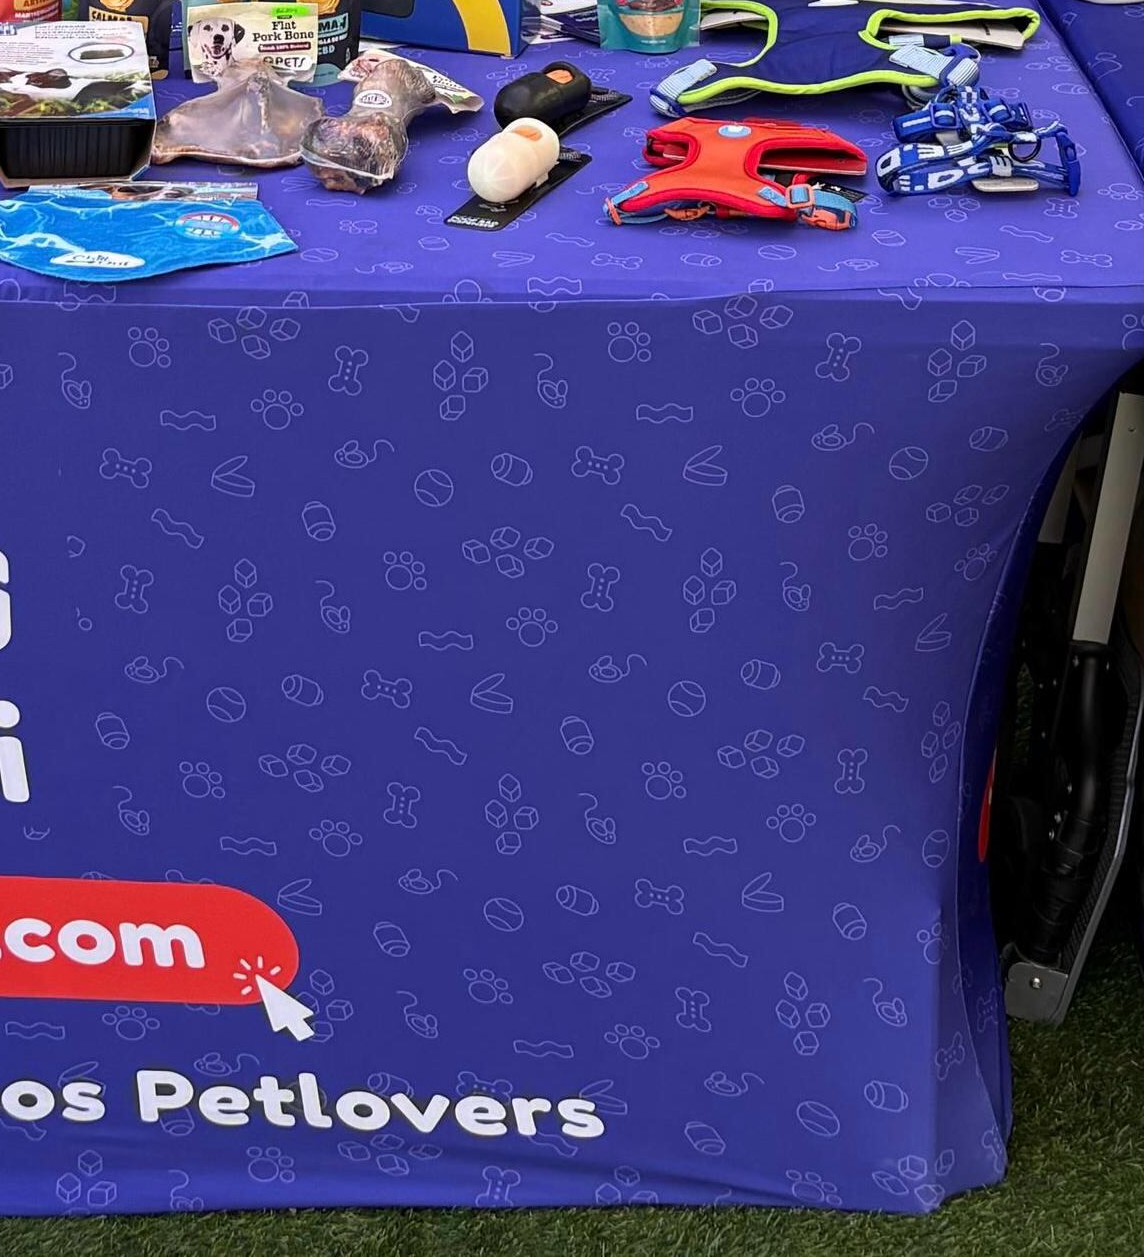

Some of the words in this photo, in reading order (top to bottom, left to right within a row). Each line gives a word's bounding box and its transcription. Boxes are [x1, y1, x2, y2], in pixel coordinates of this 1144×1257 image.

[272, 21, 297, 31] Flat
[253, 31, 282, 42] Pork
[284, 30, 314, 40] Bone
[136, 1068, 606, 1137] Petlovers
